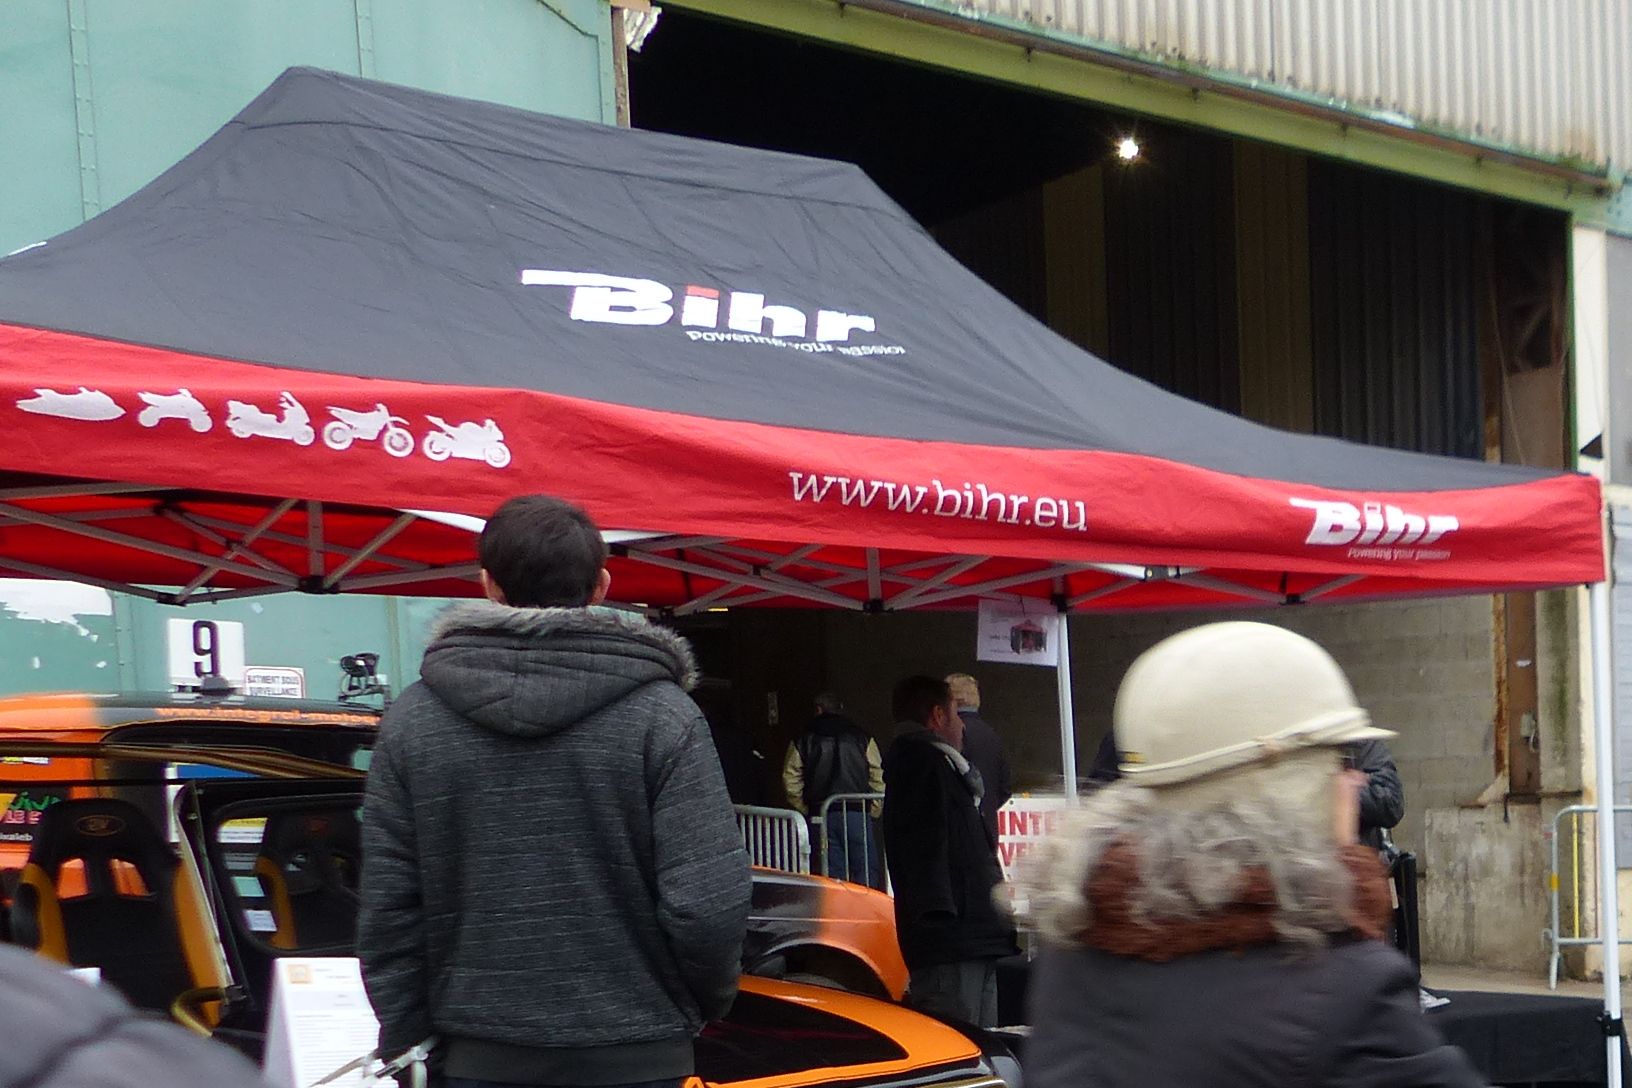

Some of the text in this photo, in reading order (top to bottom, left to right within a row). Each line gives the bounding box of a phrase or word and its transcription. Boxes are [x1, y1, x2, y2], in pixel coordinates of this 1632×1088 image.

[521, 269, 876, 341] Bihr
[789, 471, 1088, 531] www.bihr.eu
[1288, 496, 1460, 546] Bihr
[192, 619, 221, 678] 9
[998, 811, 1064, 836] INTE
